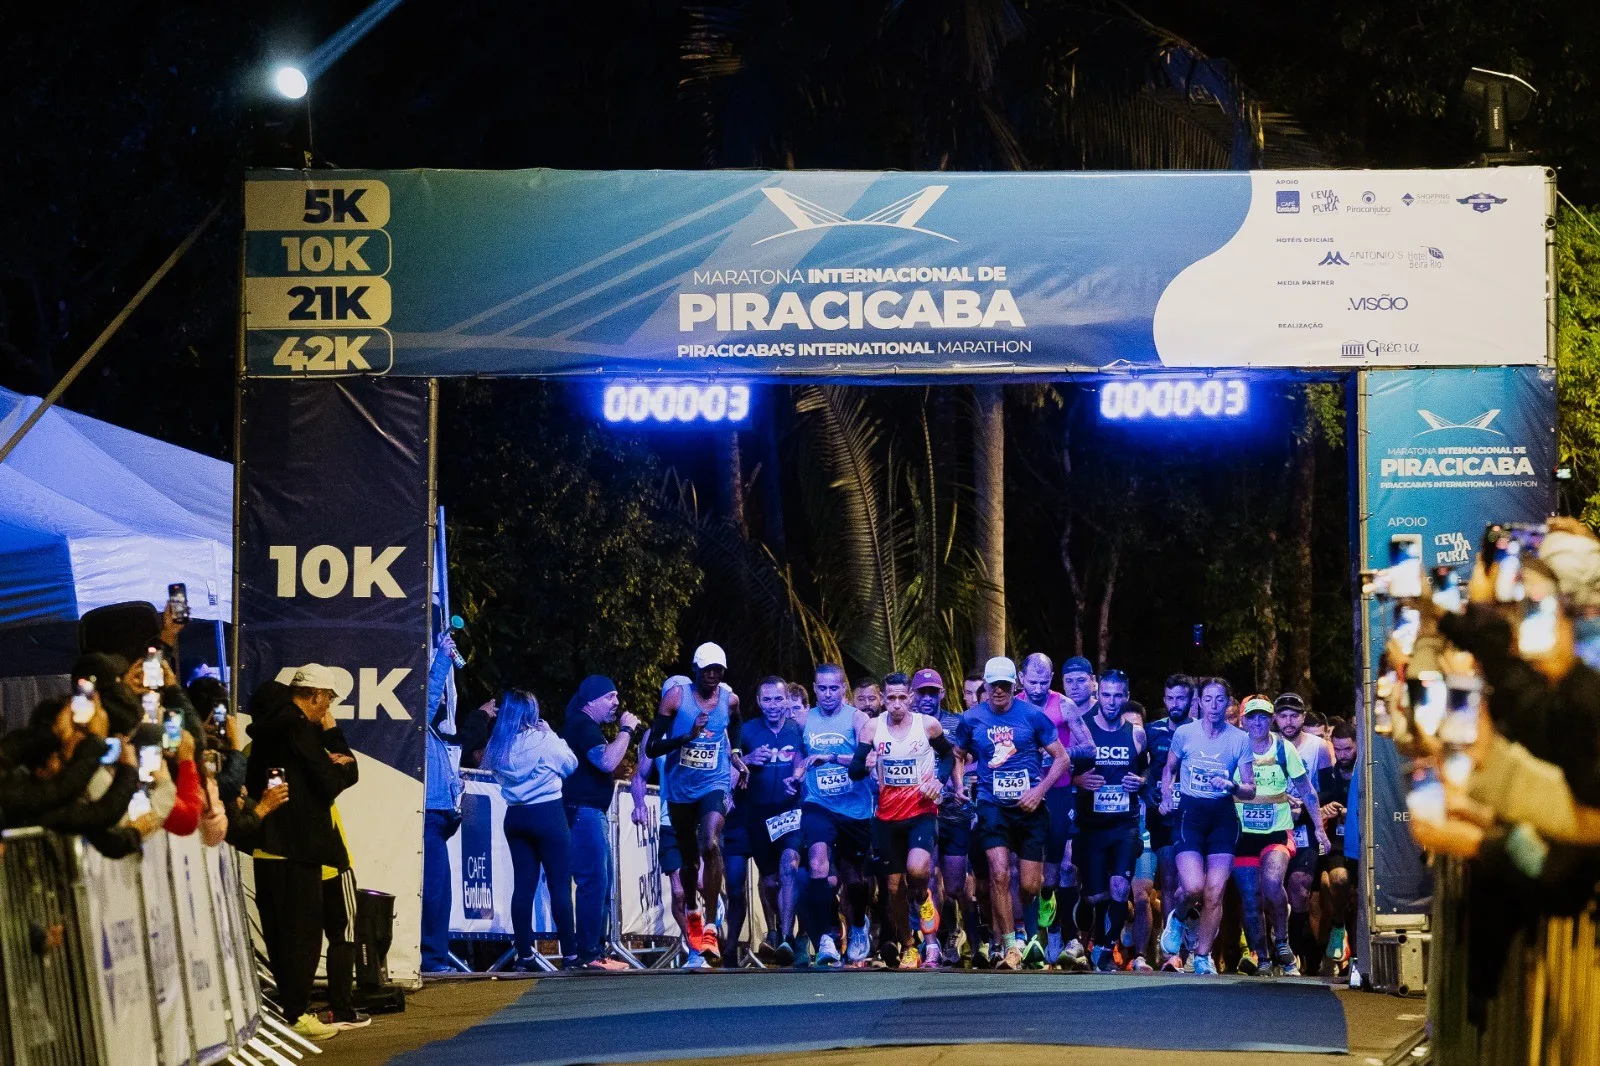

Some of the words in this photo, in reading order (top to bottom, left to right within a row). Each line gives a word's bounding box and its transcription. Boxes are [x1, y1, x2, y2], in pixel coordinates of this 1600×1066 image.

[302, 188, 369, 223] 5K
[1346, 205, 1391, 215] Piracanjuba
[281, 235, 371, 273] 10K
[693, 268, 804, 286] MARATONA
[808, 266, 973, 284] INTERNACIONAL
[978, 266, 1006, 282] DE
[287, 285, 371, 321] 21K
[678, 289, 1026, 332] PIRACICABA
[1278, 322, 1324, 330] REALIZAÇÃO
[273, 335, 371, 371] 42K
[677, 342, 796, 358] PIRACICABA'S
[799, 341, 934, 357] INTERNATIONAL
[937, 340, 1032, 354] MARATHON
[1387, 447, 1437, 456] MARATONA
[1438, 446, 1512, 455] INTERNACIONAL
[1513, 446, 1527, 455] DE
[1380, 457, 1536, 477] PIRACICABA
[1434, 481, 1494, 489] INTERNATIONAL
[1495, 480, 1538, 488] MARATHON
[1387, 516, 1428, 527] APOIO
[1436, 549, 1469, 563] PURA
[269, 544, 408, 599] 10K
[275, 666, 413, 721] 2K
[686, 750, 715, 760] 4205
[887, 766, 913, 775] 4201
[821, 774, 848, 786] 4345
[997, 778, 1024, 788] 4349
[1098, 793, 1124, 802] 4447
[1245, 810, 1272, 819] 2255
[467, 852, 487, 879] CAFÉ
